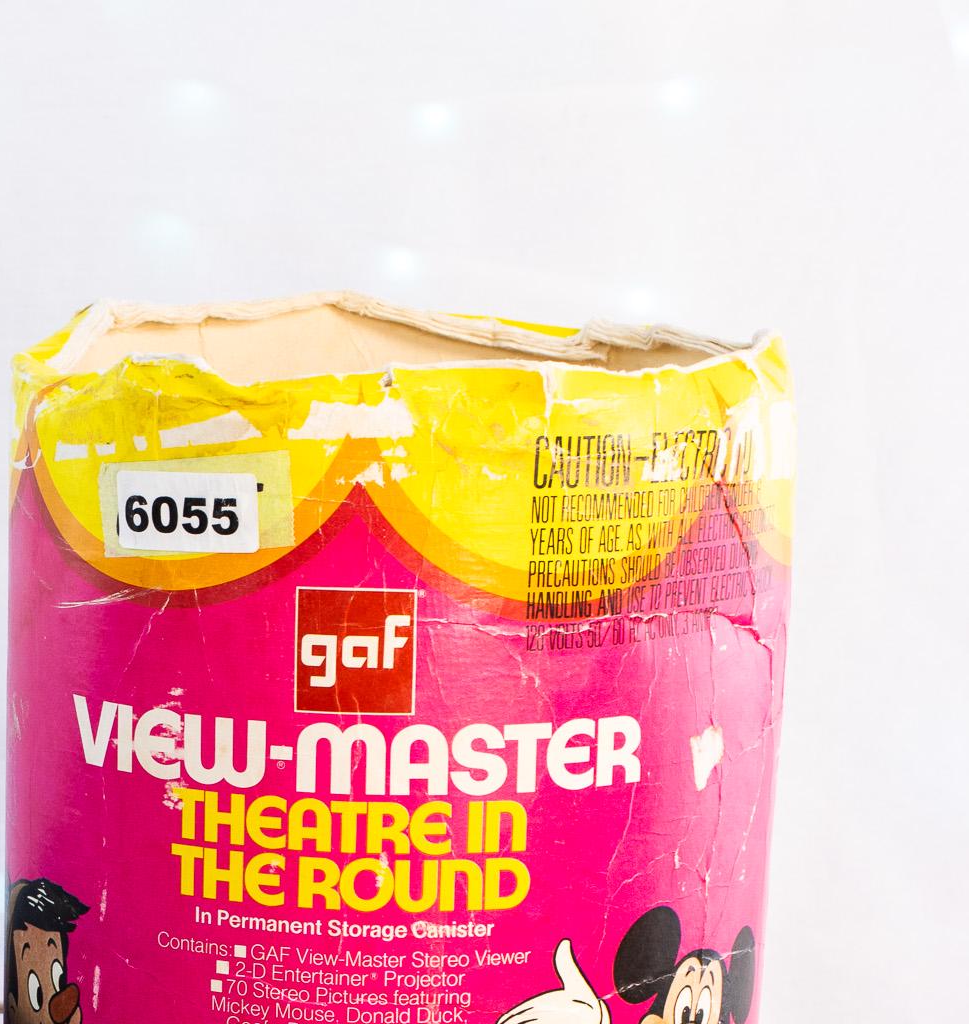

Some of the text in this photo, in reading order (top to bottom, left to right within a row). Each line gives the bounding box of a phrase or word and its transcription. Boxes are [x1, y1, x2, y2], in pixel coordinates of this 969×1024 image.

[125, 495, 239, 535] 6055
[531, 495, 557, 523] NOT
[561, 491, 654, 522] RECOMMENDED
[658, 488, 675, 516] FOR
[531, 528, 573, 556] YEARS
[579, 526, 594, 553] OF
[599, 525, 623, 552] AGE.
[627, 524, 642, 551] AS
[646, 521, 674, 549] WITH
[528, 558, 616, 588] PRECAUTIONS
[621, 554, 661, 584] SHOULD
[665, 552, 677, 579] BE
[680, 545, 727, 577] OBSERVED
[527, 590, 592, 620] HANDLING
[598, 588, 623, 616] AND
[626, 585, 646, 613] USE
[649, 583, 662, 611] TO
[665, 577, 708, 609] PREVENT
[710, 571, 749, 602] ELECTRIC
[301, 614, 410, 687] gaf
[525, 624, 546, 651] 120
[548, 622, 583, 650] VOLTS
[73, 694, 641, 796] VIEW-MASTER
[172, 787, 527, 854] THEATRE IN
[171, 843, 531, 912] THE ROUND
[195, 906, 495, 942] In Permanent Storage Canister
[157, 931, 532, 969] Contains: GAF View-Master Stereo Viewer
[226, 979, 472, 1009] 70 Stereo Pictures featuring
[235, 961, 266, 979] 2-D
[384, 971, 466, 991] Projector
[211, 995, 468, 1024] Mickey Mouse, Donald Duck,
